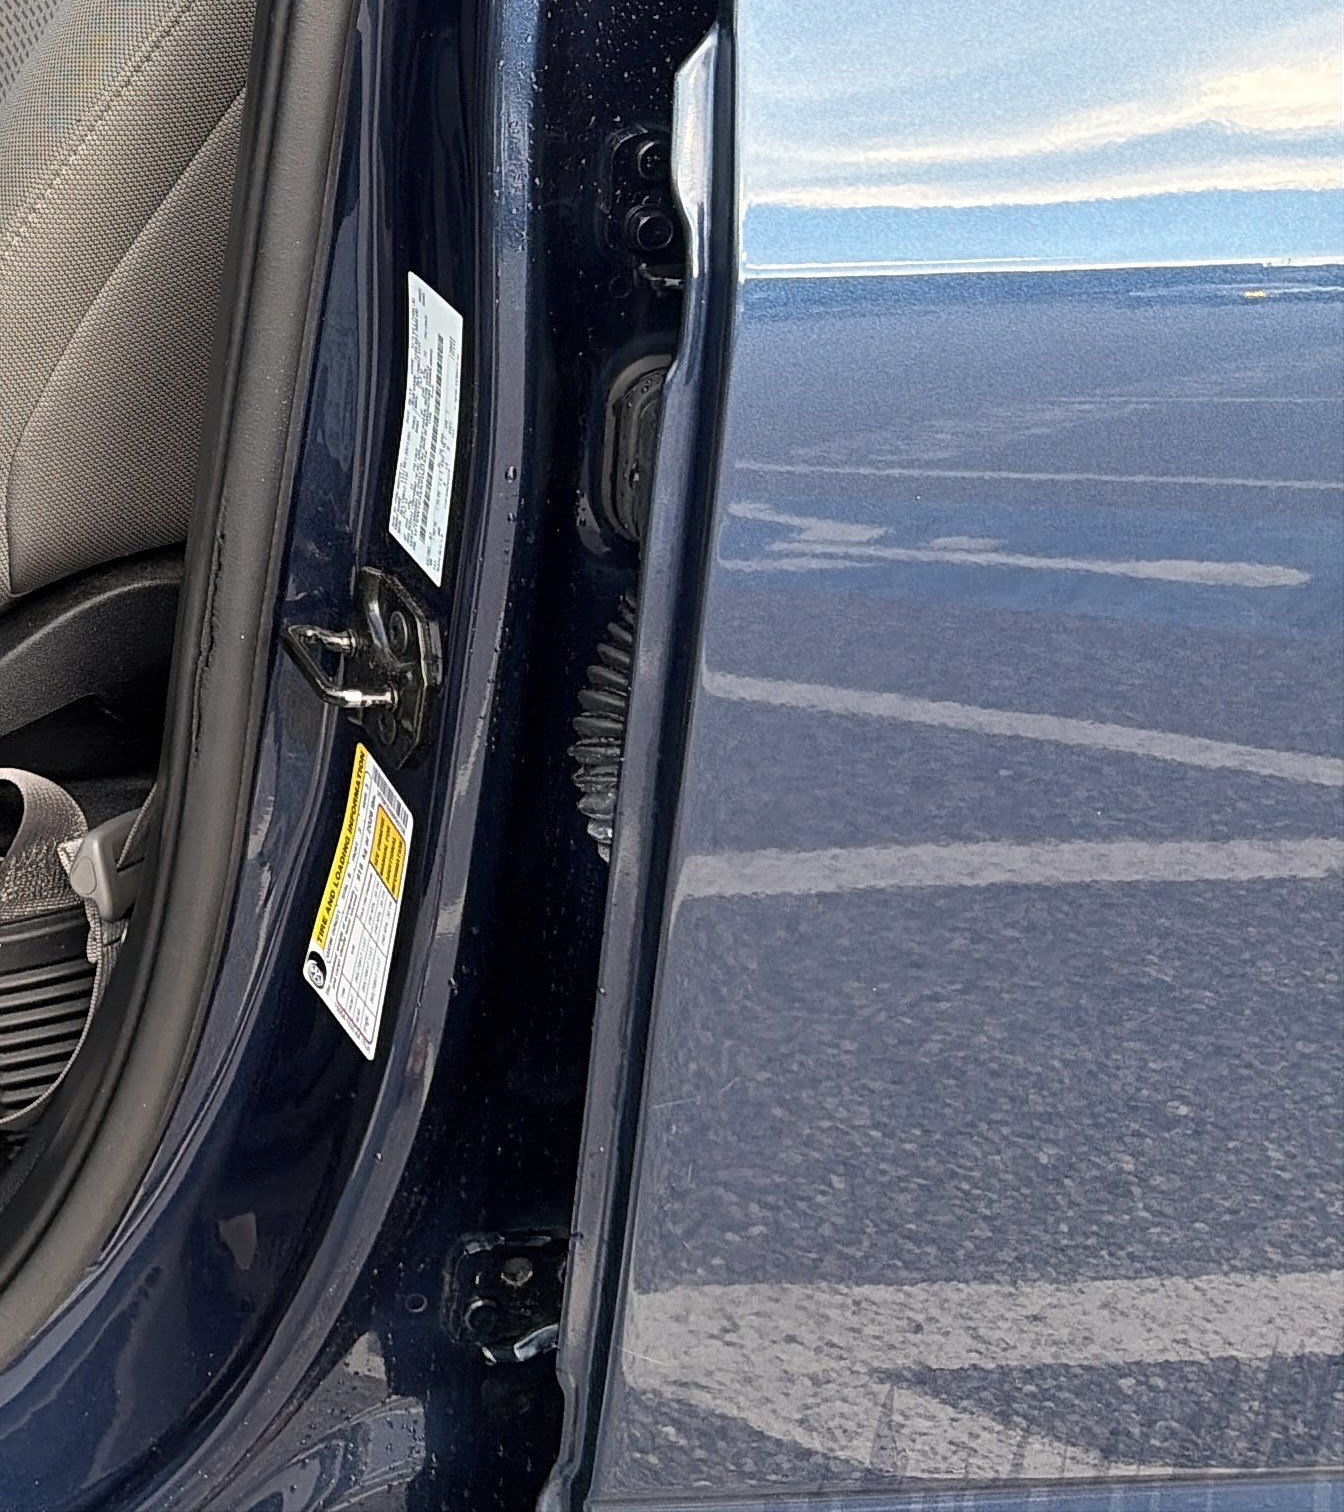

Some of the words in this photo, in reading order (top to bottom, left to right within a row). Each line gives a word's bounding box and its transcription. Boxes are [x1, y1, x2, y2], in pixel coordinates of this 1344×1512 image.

[316, 915, 328, 943] TIRE
[324, 887, 335, 916] AND
[333, 833, 350, 889] LOADING
[347, 749, 365, 835] INFORMATION
